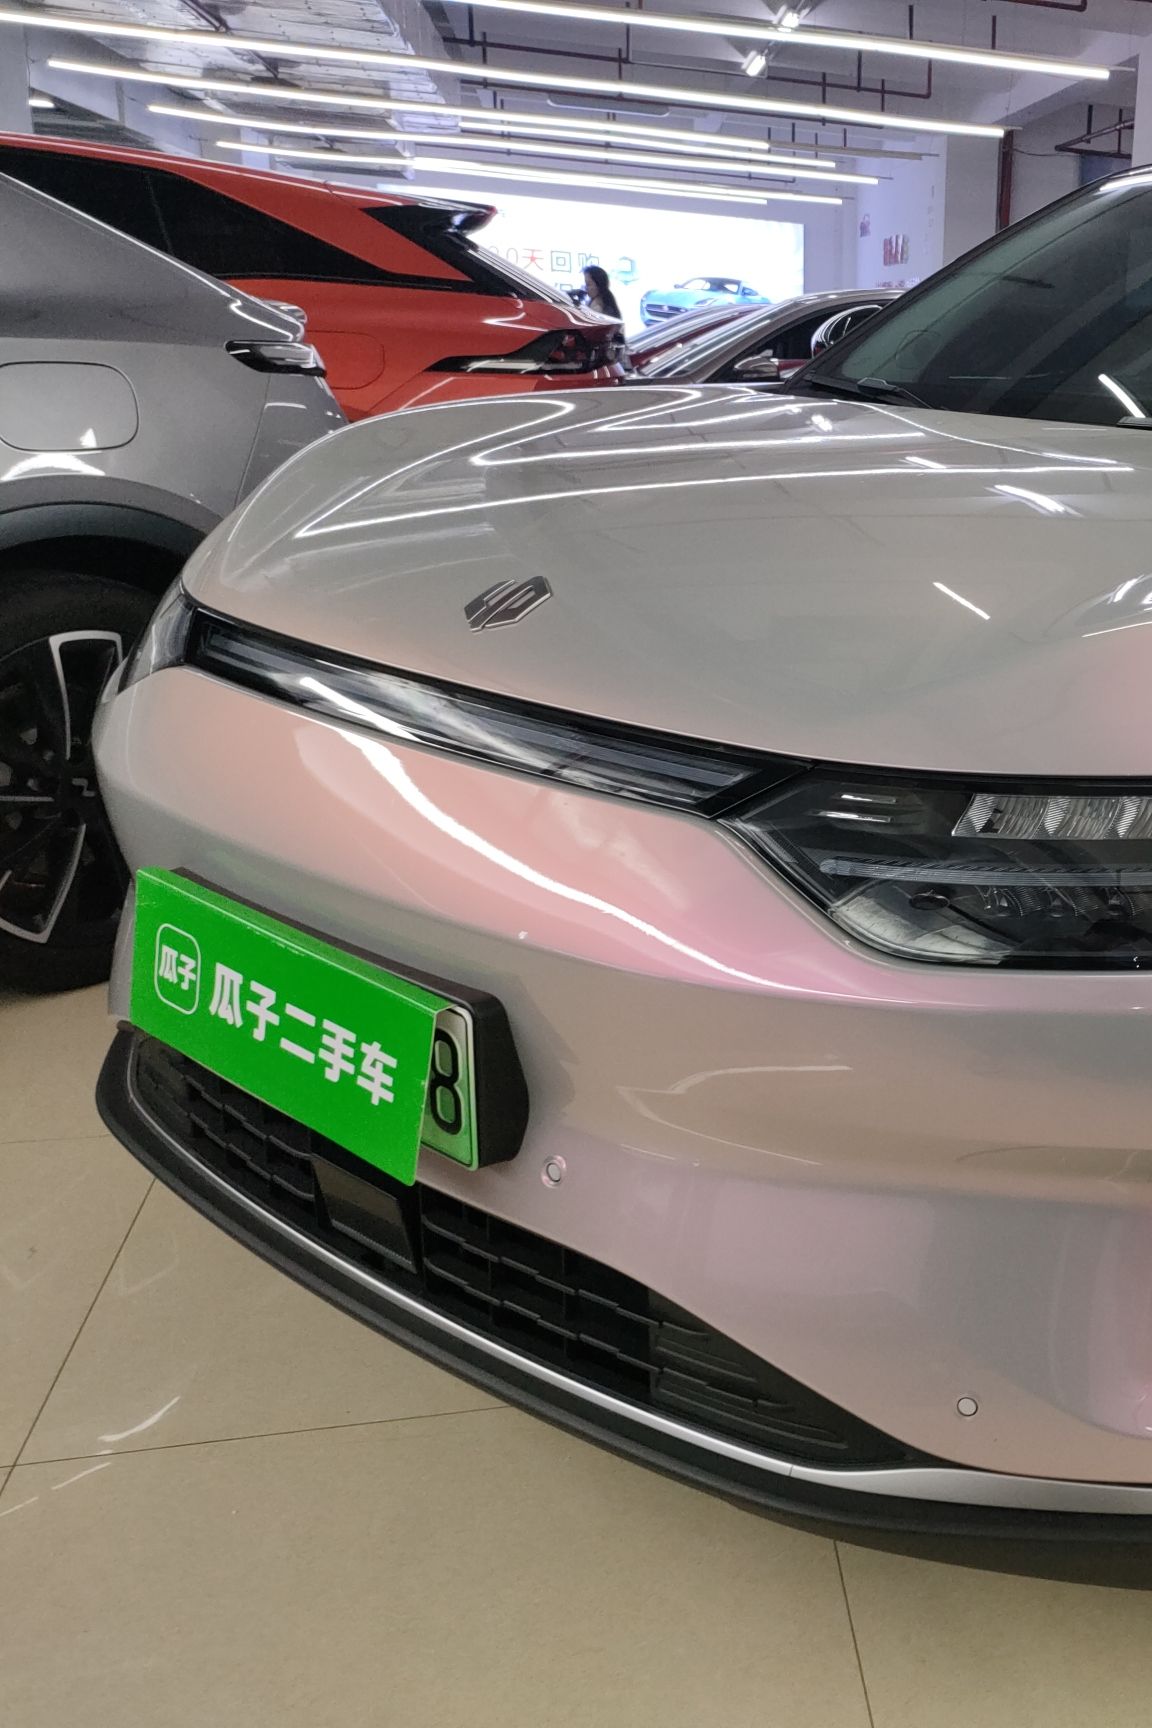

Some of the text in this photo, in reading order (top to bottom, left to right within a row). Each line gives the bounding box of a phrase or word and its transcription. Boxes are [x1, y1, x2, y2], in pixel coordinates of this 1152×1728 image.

[159, 944, 196, 990] 瓜子
[208, 962, 397, 1106] 瓜子二手车
[430, 1027, 462, 1135] 8
